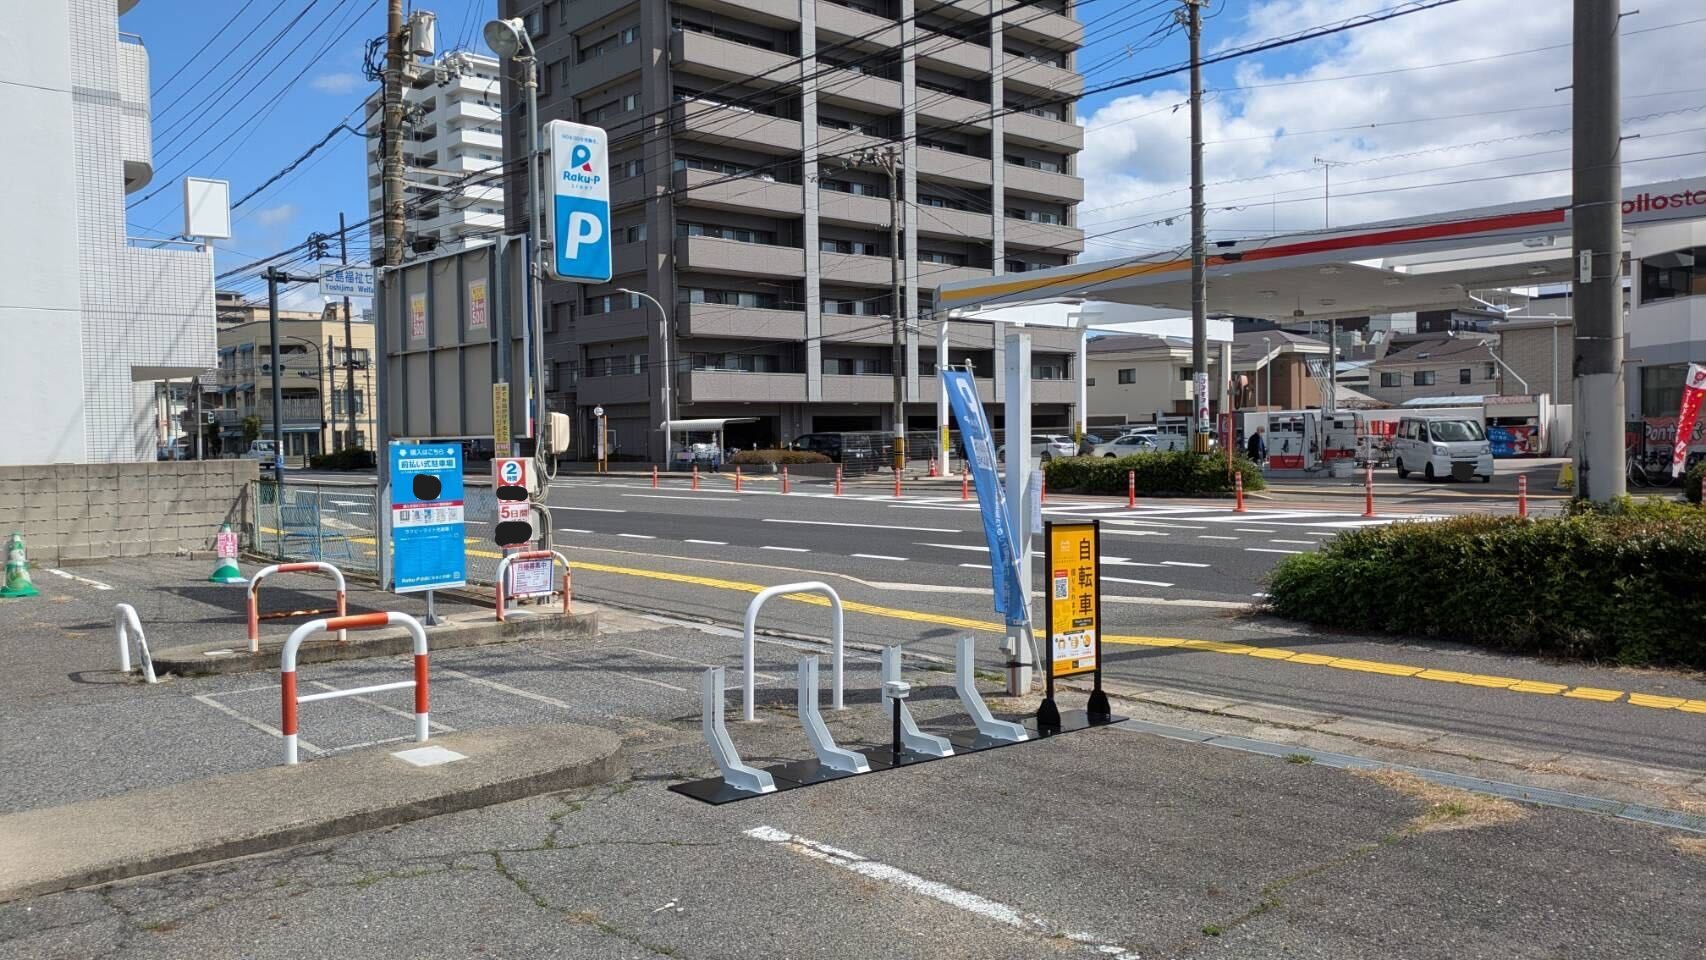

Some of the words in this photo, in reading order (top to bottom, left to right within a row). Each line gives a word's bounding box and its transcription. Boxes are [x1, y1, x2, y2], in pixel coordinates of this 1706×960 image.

[563, 170, 600, 184] Raku-P
[565, 211, 602, 259] P
[506, 463, 517, 474] 2
[501, 506, 528, 518] 5日間
[1078, 537, 1093, 615] 自転車
